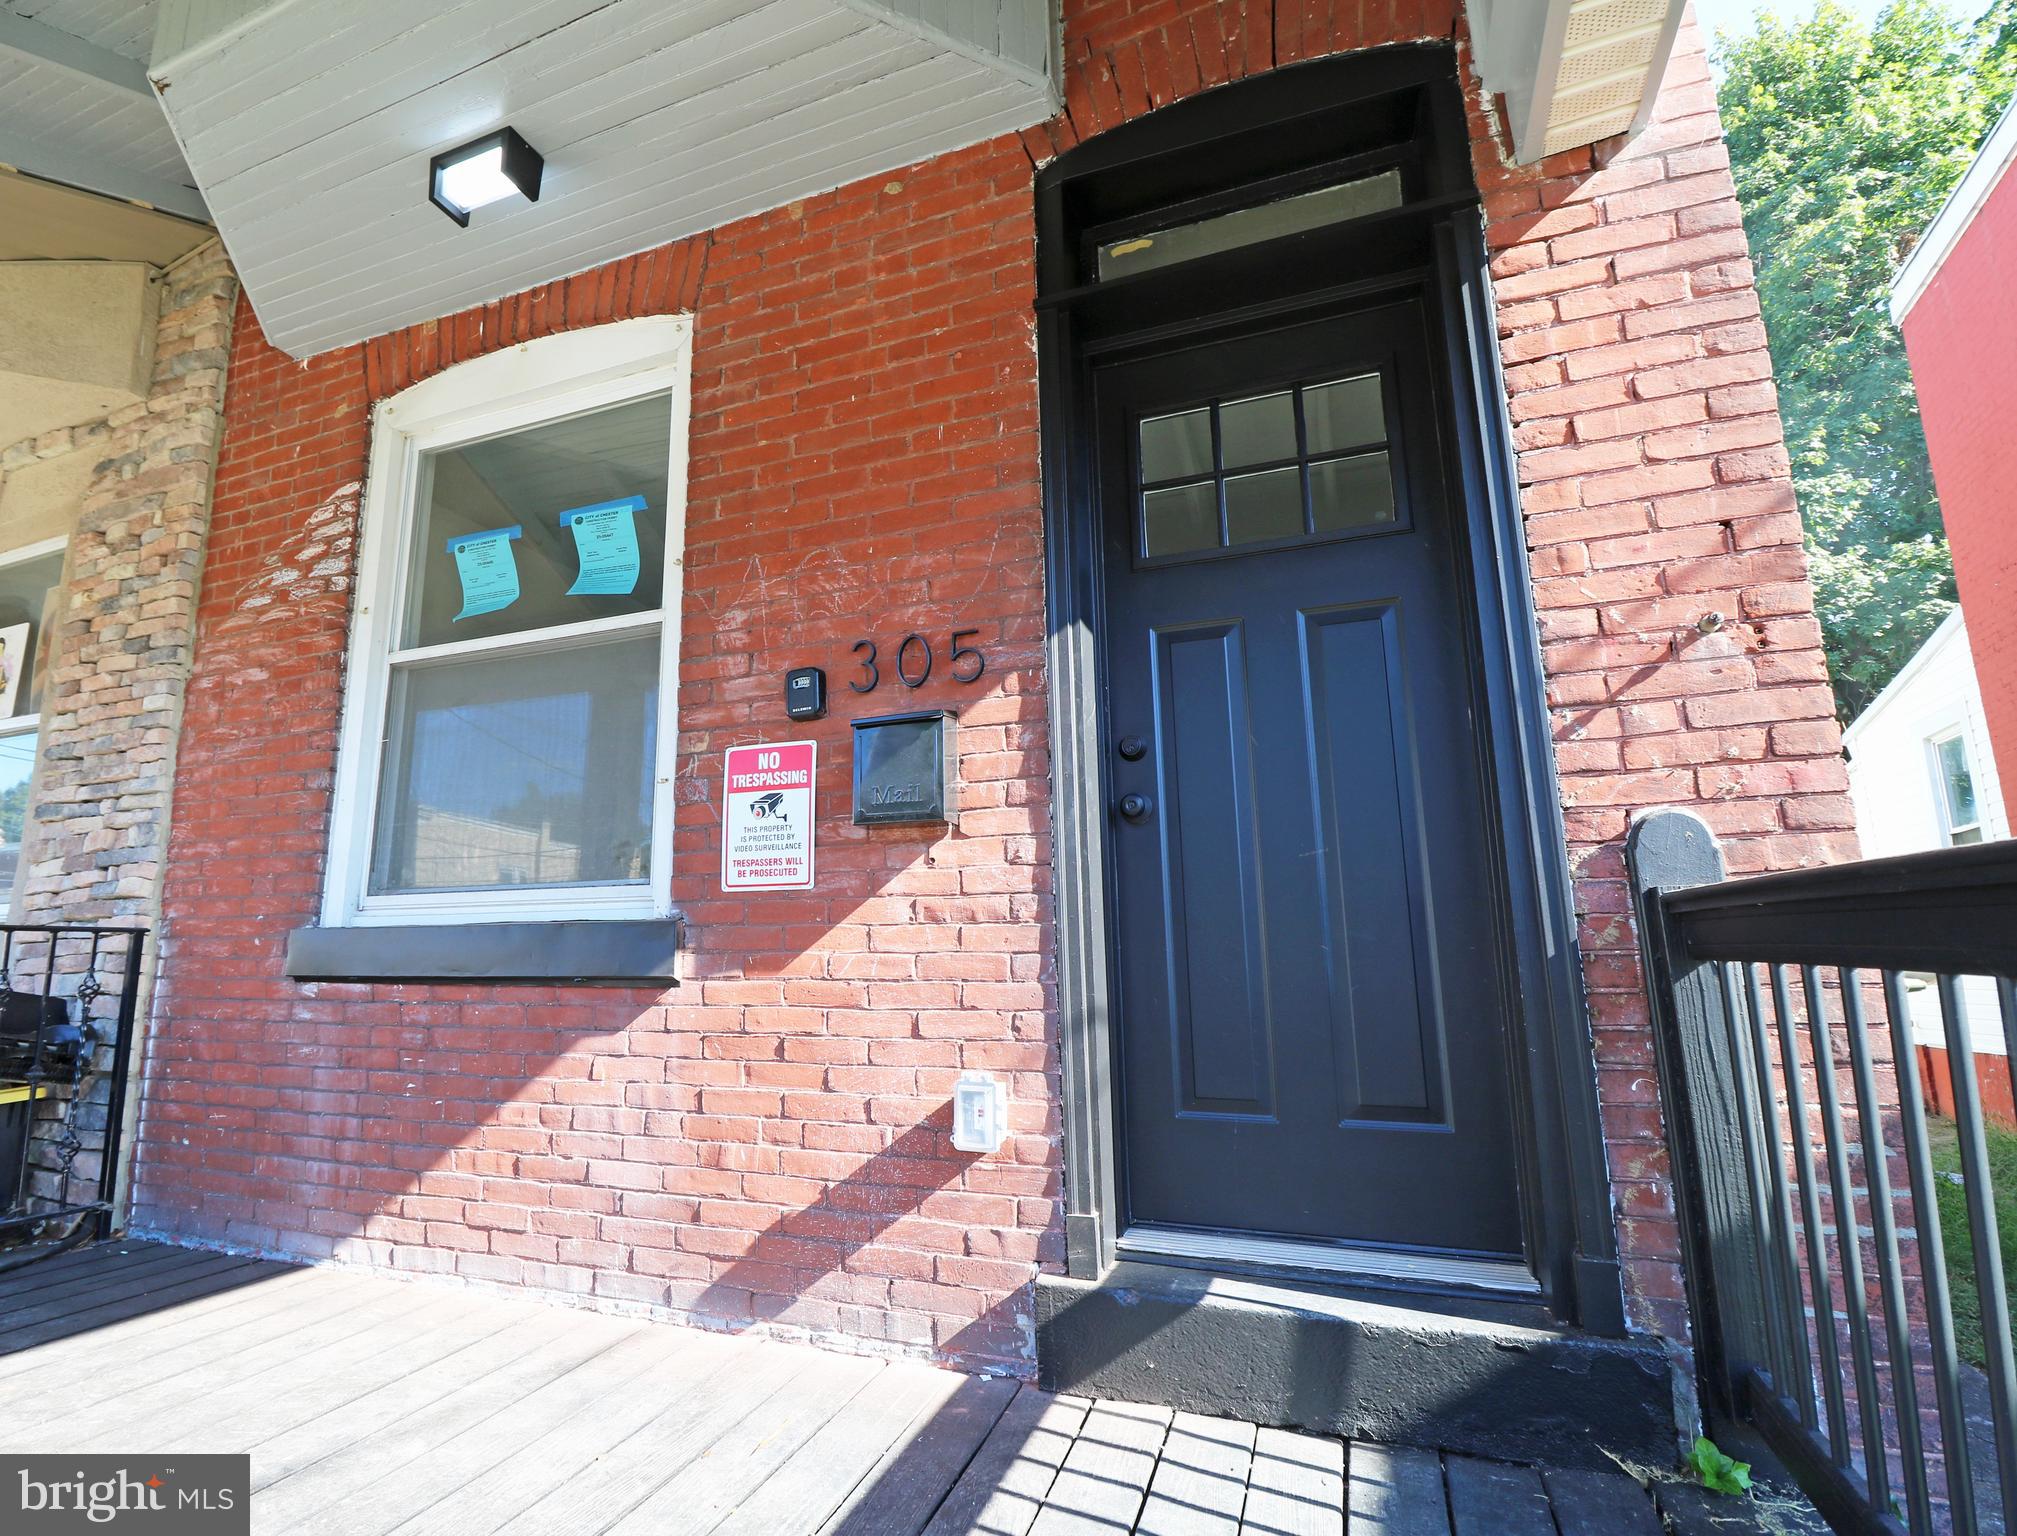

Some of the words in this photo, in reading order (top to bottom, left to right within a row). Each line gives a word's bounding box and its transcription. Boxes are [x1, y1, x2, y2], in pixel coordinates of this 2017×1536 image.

[848, 628, 985, 693] 305
[758, 752, 780, 770] NO
[732, 770, 808, 788] TRESPASSING
[871, 783, 923, 807] Mail
[748, 834, 785, 842] PROTECTED
[734, 844, 752, 853] VIDEO
[754, 842, 802, 852] SURVEILLANCE
[732, 857, 783, 868] TRESPASSERS
[785, 856, 804, 865] WILL
[737, 870, 747, 878] BE
[749, 868, 798, 877] PROSECUTED
